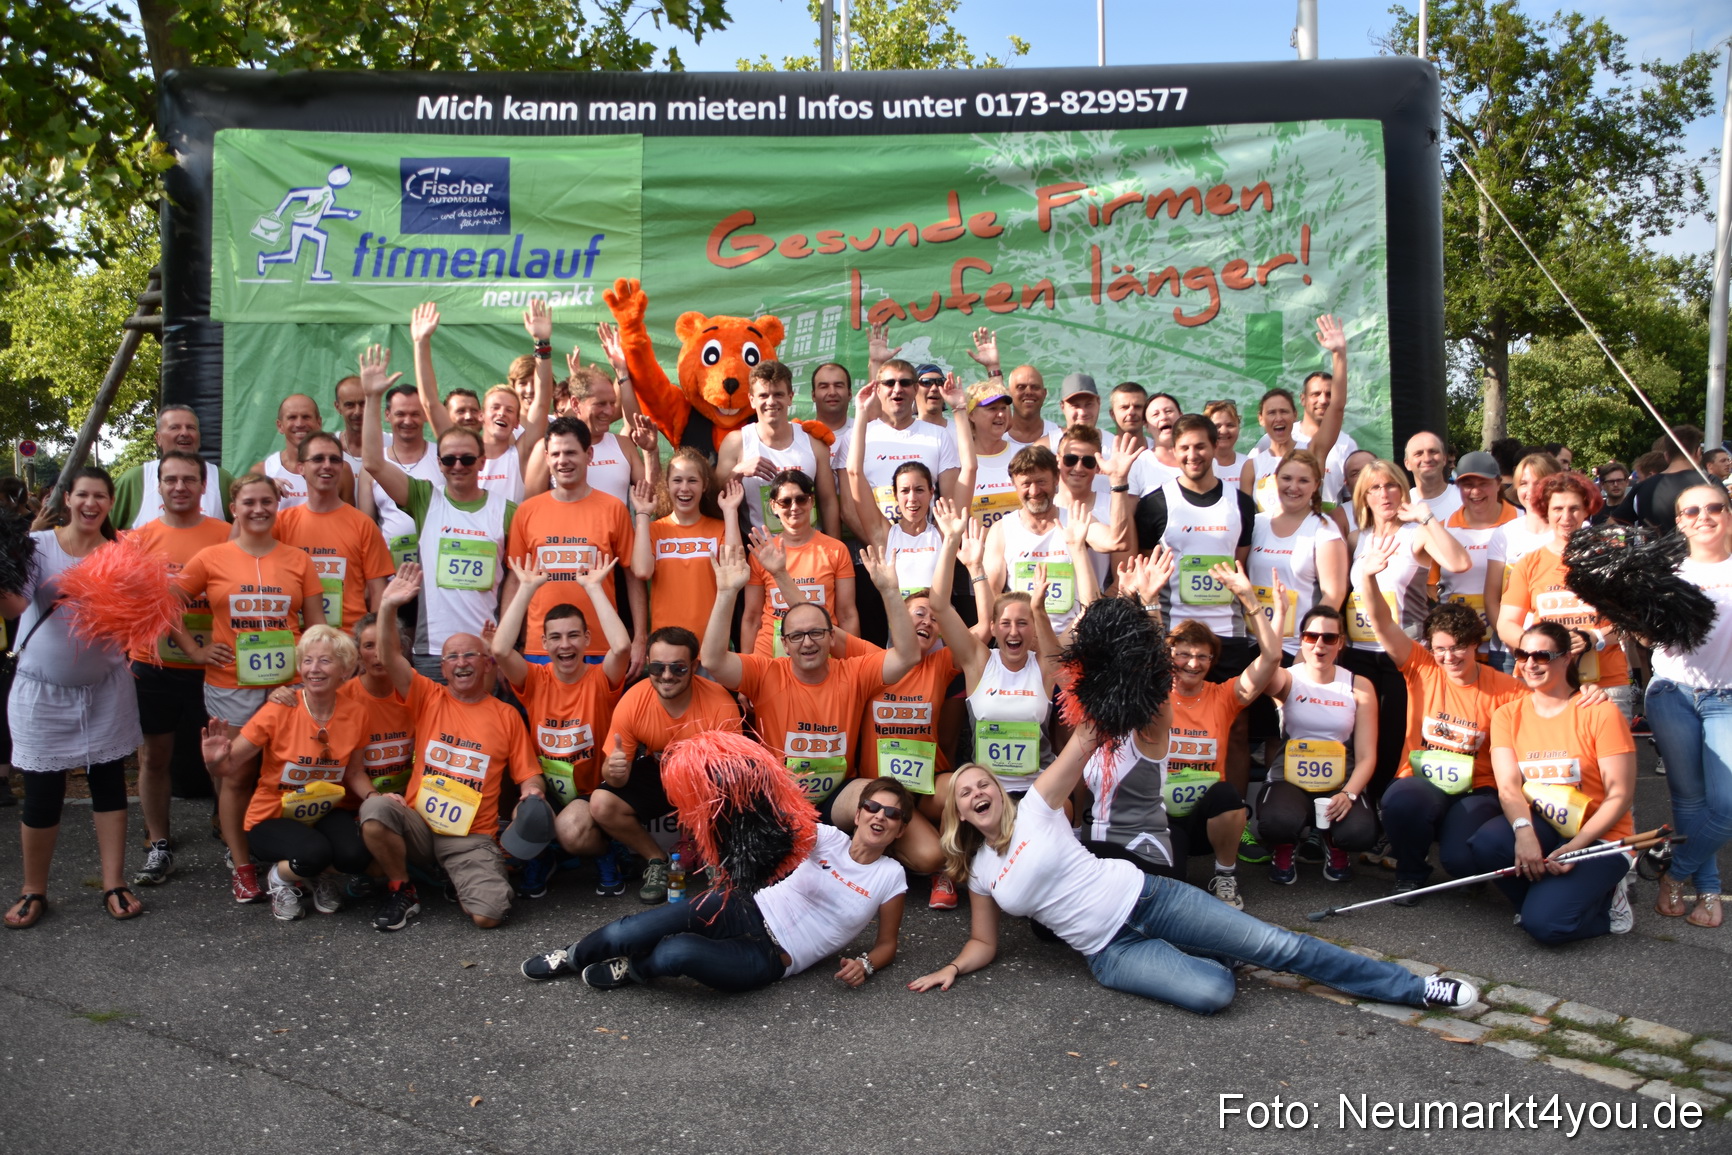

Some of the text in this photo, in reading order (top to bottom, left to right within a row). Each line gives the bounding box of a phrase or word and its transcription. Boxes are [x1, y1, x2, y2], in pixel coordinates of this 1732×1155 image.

[417, 87, 1188, 121] Mich kann man mieten! Infos unter 0173-8299577
[421, 180, 493, 195] Fischer
[428, 196, 488, 204] AUTOMOBILE
[441, 211, 456, 220] und
[457, 209, 473, 218] das
[483, 217, 502, 225] mit!
[706, 180, 1275, 269] Gesunde Firmen
[352, 232, 606, 279] firmenlauf
[851, 223, 1314, 331] laufen länger!
[482, 284, 596, 307] neumarkt
[453, 528, 488, 537] KLEBL
[546, 535, 587, 544] 30 Jahre
[659, 541, 712, 554] OBI
[541, 550, 592, 564] OBI
[449, 559, 483, 576] 578
[240, 584, 282, 593] 30 Jahre
[234, 597, 287, 613] OBI
[231, 618, 288, 629] Neumarkt
[249, 652, 286, 671] 613
[883, 692, 923, 702] 30 Jahre
[999, 688, 1038, 697] KLEBL
[1309, 697, 1347, 708] KLEBL
[876, 706, 928, 720] OBI
[1436, 711, 1478, 728] 30 Jahre
[545, 718, 558, 728] 30
[798, 722, 838, 732] 30 Jahre
[875, 723, 932, 736] Neumarkt
[370, 731, 407, 742] 30 Jahre
[541, 730, 588, 748] OBI
[1184, 728, 1208, 736] Jahre
[440, 732, 482, 750] 30 Jahre
[790, 737, 842, 753] OBI
[364, 742, 412, 762] OBI
[429, 746, 484, 772] OBI
[988, 742, 1026, 760] 617
[1543, 750, 1568, 759] Jahre
[298, 756, 312, 764] 30
[890, 758, 924, 778] 627
[288, 768, 342, 782] OBI
[1296, 760, 1333, 778] 596
[1421, 764, 1459, 782] 615
[1523, 764, 1574, 780] OBI
[294, 800, 332, 818] 609
[425, 796, 462, 823] 610
[1532, 798, 1568, 826] 608
[998, 839, 1030, 882] KLEBL
[831, 869, 872, 899] KLEBL
